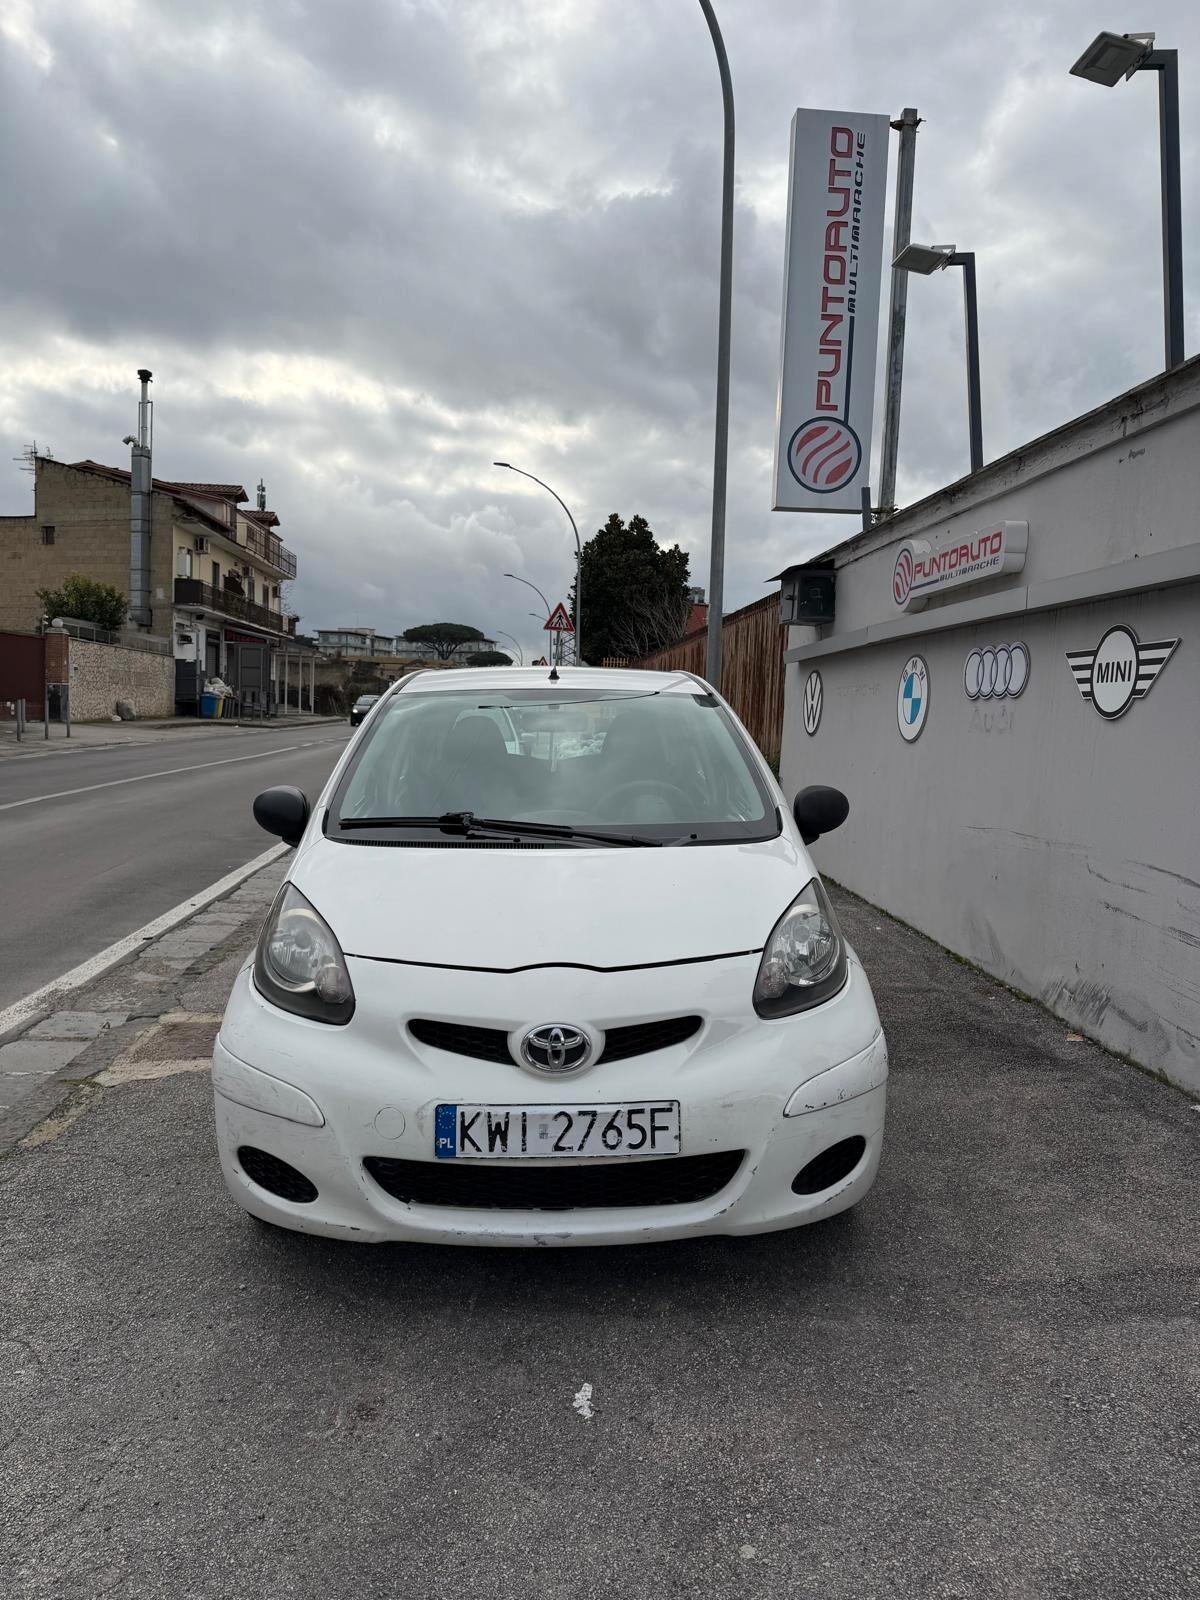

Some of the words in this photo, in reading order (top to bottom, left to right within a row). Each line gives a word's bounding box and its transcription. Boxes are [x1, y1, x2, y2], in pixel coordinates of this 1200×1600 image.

[848, 131, 867, 314] MULTIMARCHE
[816, 127, 854, 411] PUNTOAUTO
[913, 531, 1003, 582] PUNTOAUTO
[1096, 659, 1133, 684] MINI
[439, 1137, 454, 1149] PL
[459, 1111, 527, 1153] KWI
[552, 1107, 673, 1152] 2765F
